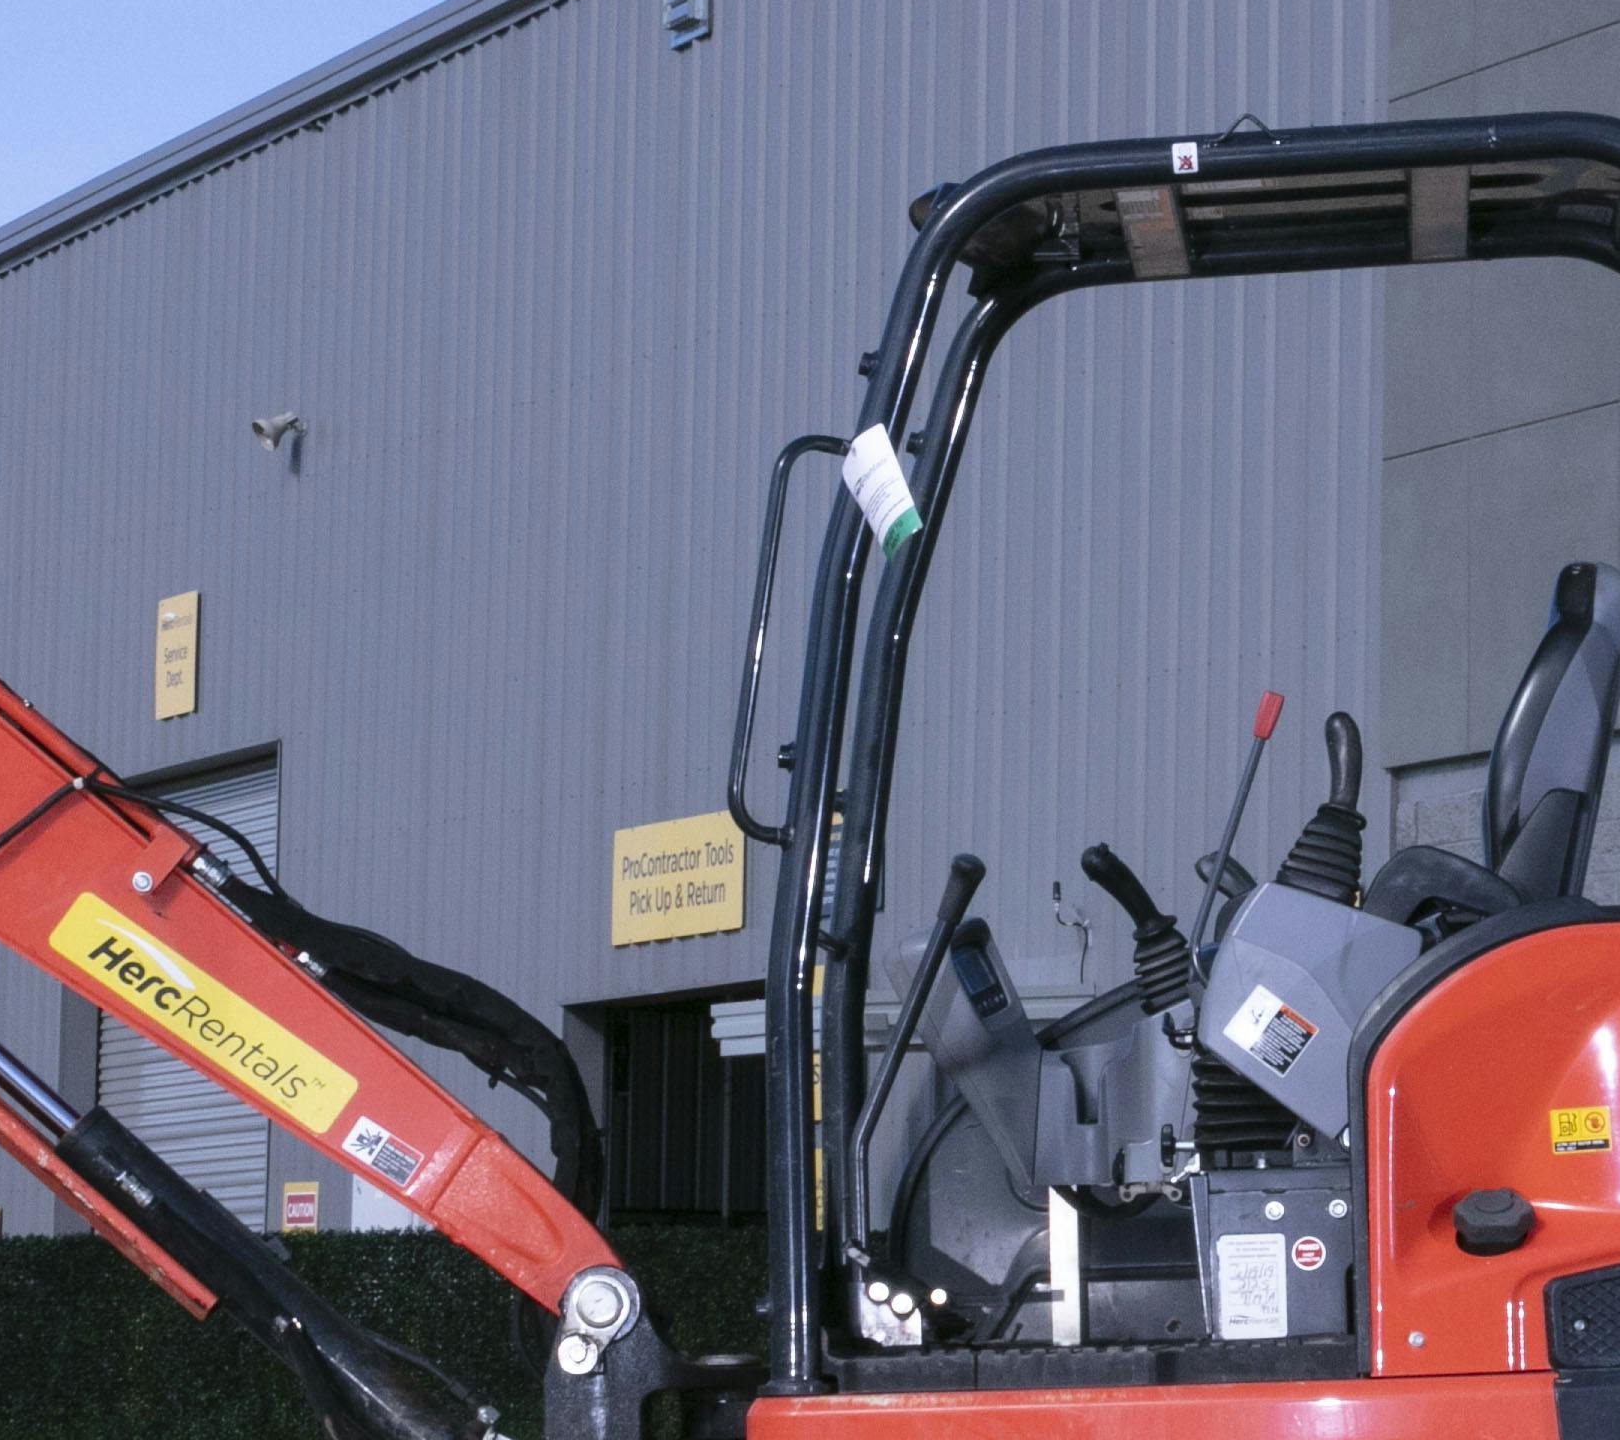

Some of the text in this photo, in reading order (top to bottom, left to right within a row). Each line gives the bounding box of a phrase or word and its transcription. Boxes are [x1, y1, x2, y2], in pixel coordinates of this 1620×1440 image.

[164, 646, 188, 664] Service
[622, 837, 734, 880] ProContractor Tools
[630, 881, 726, 916] Pick Up & Return
[88, 936, 307, 1100] HercRentals
